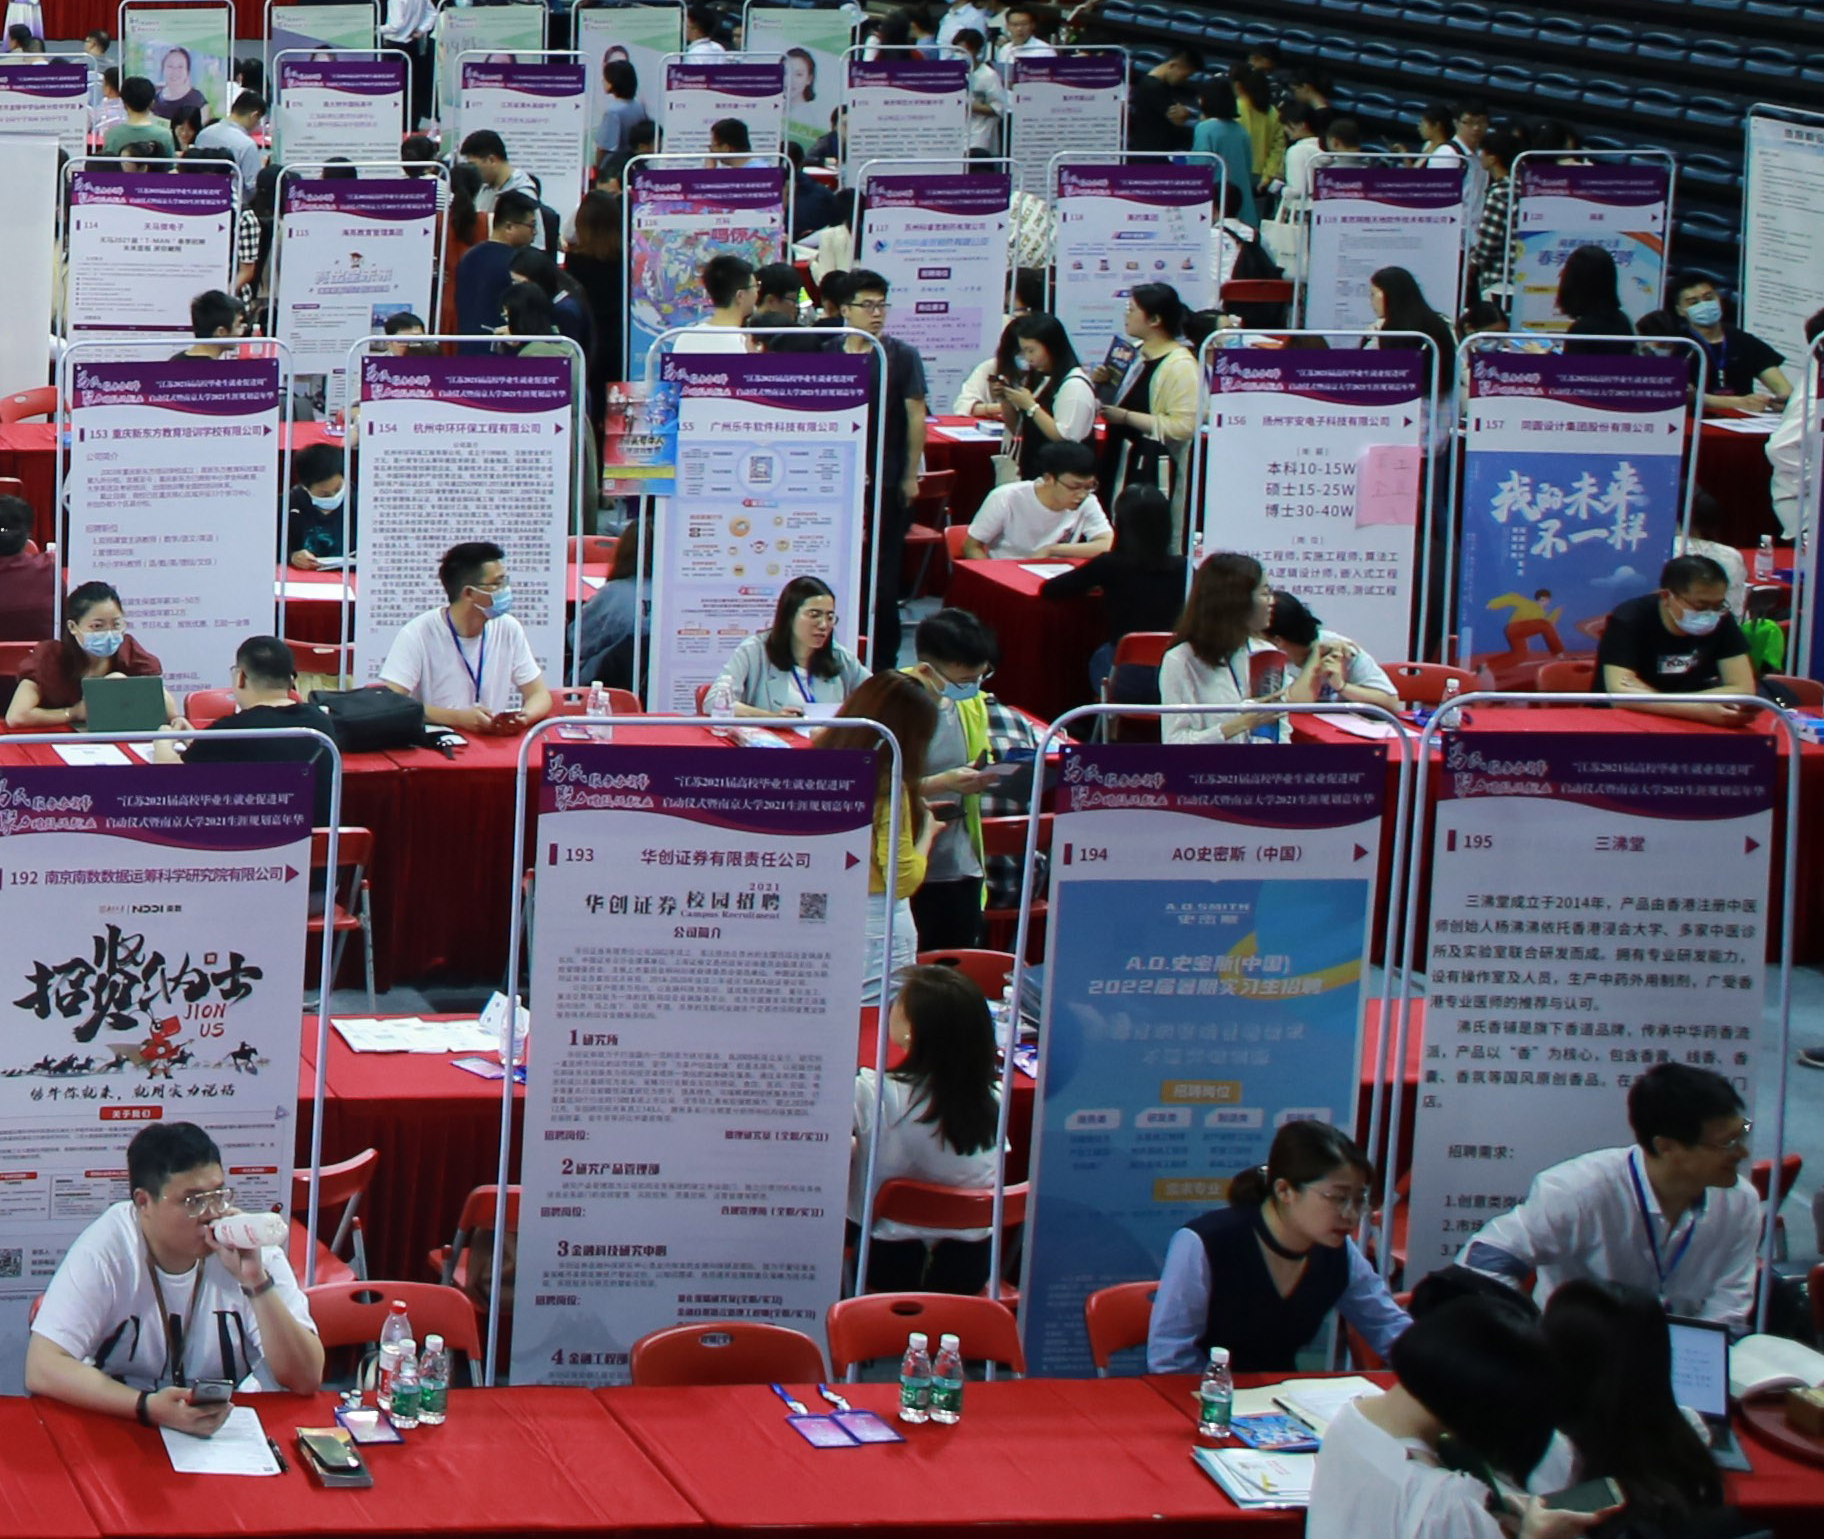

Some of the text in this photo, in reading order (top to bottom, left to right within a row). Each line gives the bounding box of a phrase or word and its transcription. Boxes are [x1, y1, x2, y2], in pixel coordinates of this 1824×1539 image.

[378, 423, 540, 434] 154 杭州中环环保工程有限公司
[710, 420, 839, 433] 广州乐牛软件科技有限公司
[1227, 416, 1246, 426] 156
[1486, 420, 1505, 430] 157
[89, 429, 107, 439] 153
[1266, 462, 1356, 476] 本科10-15W
[1264, 483, 1356, 498] 硕士15-25W
[1489, 461, 1647, 524] 我的未来
[1264, 504, 1354, 519] 博士30-40W
[1530, 513, 1649, 558] 不一样
[1464, 835, 1645, 852] 195 三沸堂
[565, 848, 811, 868] 193 华创证券有限责任公司
[1080, 845, 1303, 862] 194 AO史密斯（中国）
[10, 866, 283, 885] 192 南京南数数据运筹科学研究院有限公司
[749, 882, 781, 892] 2021
[584, 889, 781, 917] 华创证券 校园招聘
[12, 923, 264, 1043] 招贤纳士
[183, 1002, 227, 1020] JION
[199, 1022, 225, 1038] US
[561, 1158, 574, 1175] 2
[557, 1241, 570, 1257] 3
